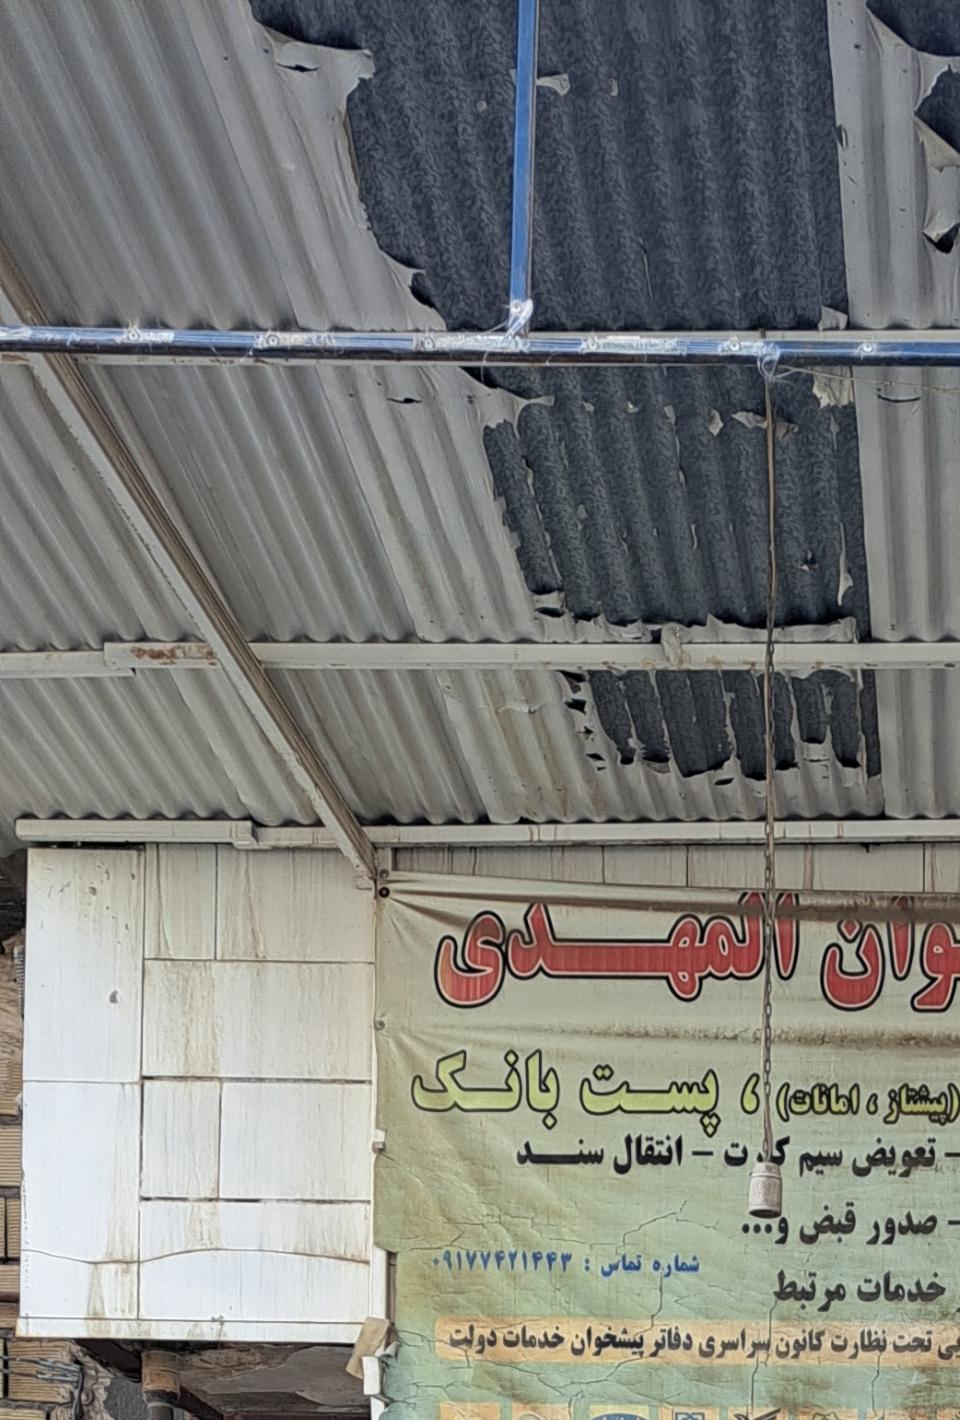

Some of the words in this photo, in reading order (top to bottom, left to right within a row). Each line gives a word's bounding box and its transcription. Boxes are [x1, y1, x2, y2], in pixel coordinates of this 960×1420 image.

[435, 892, 800, 1008] المهدی
[411, 1049, 561, 1130] بانک
[579, 1064, 720, 1137] پست
[517, 1139, 604, 1168] سند
[614, 1135, 683, 1175] انتقال
[799, 1147, 843, 1178] سیم
[852, 1137, 936, 1178] تعویض
[800, 1202, 856, 1245] قبض
[867, 1209, 938, 1248] صدور
[432, 1249, 573, 1273] ۰۹۱۷۷۴۲۱۴۴۳
[600, 1253, 642, 1275] تماس
[651, 1255, 700, 1277] شماره
[772, 1270, 847, 1312] مرتبط
[857, 1271, 946, 1305] خدمات
[449, 1324, 497, 1353] دولت
[502, 1325, 565, 1350] خدمات
[571, 1325, 645, 1357] پیشخوان
[648, 1326, 693, 1358] دفاتر
[698, 1326, 771, 1360] سراسری
[775, 1329, 826, 1360] کانون
[830, 1328, 888, 1355] نظارت
[892, 1330, 933, 1354] تحت
